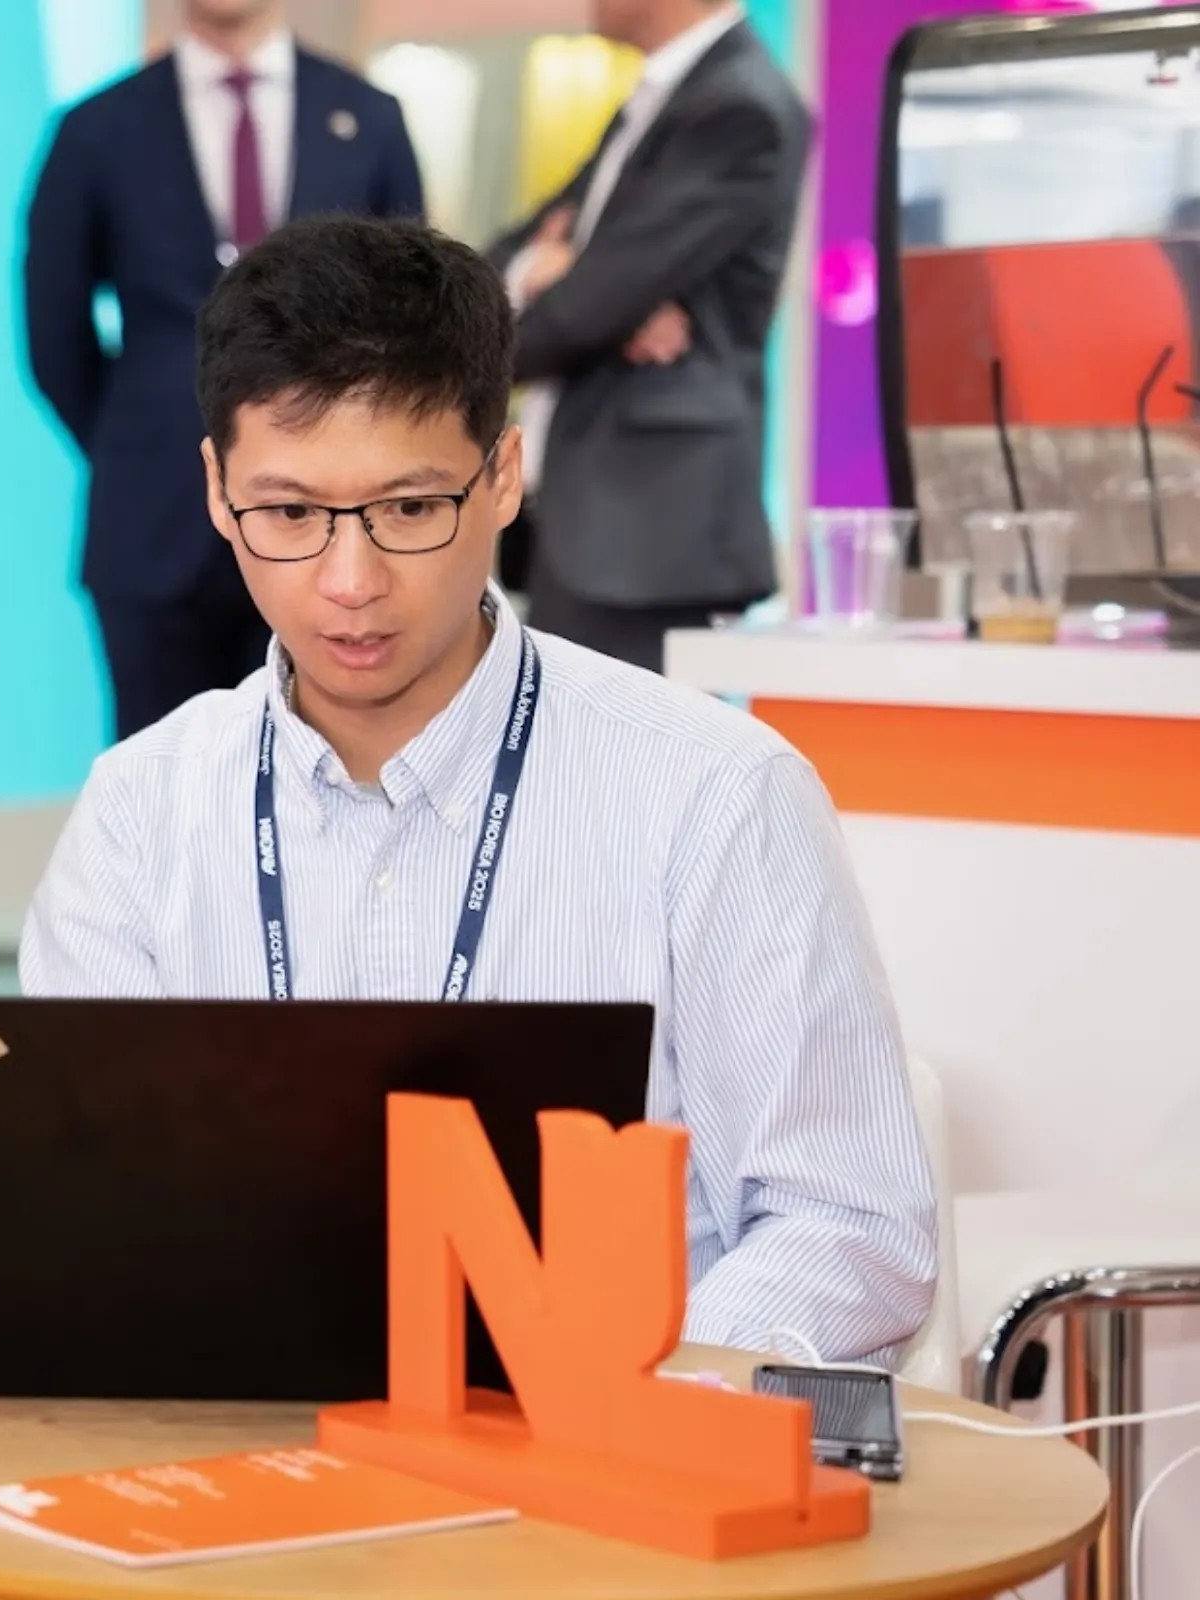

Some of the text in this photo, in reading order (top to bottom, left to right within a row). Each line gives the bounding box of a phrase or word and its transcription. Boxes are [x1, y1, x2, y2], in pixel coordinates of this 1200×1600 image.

[468, 793, 508, 911] BIO KOREA 2025
[268, 919, 287, 999] OREA 2025
